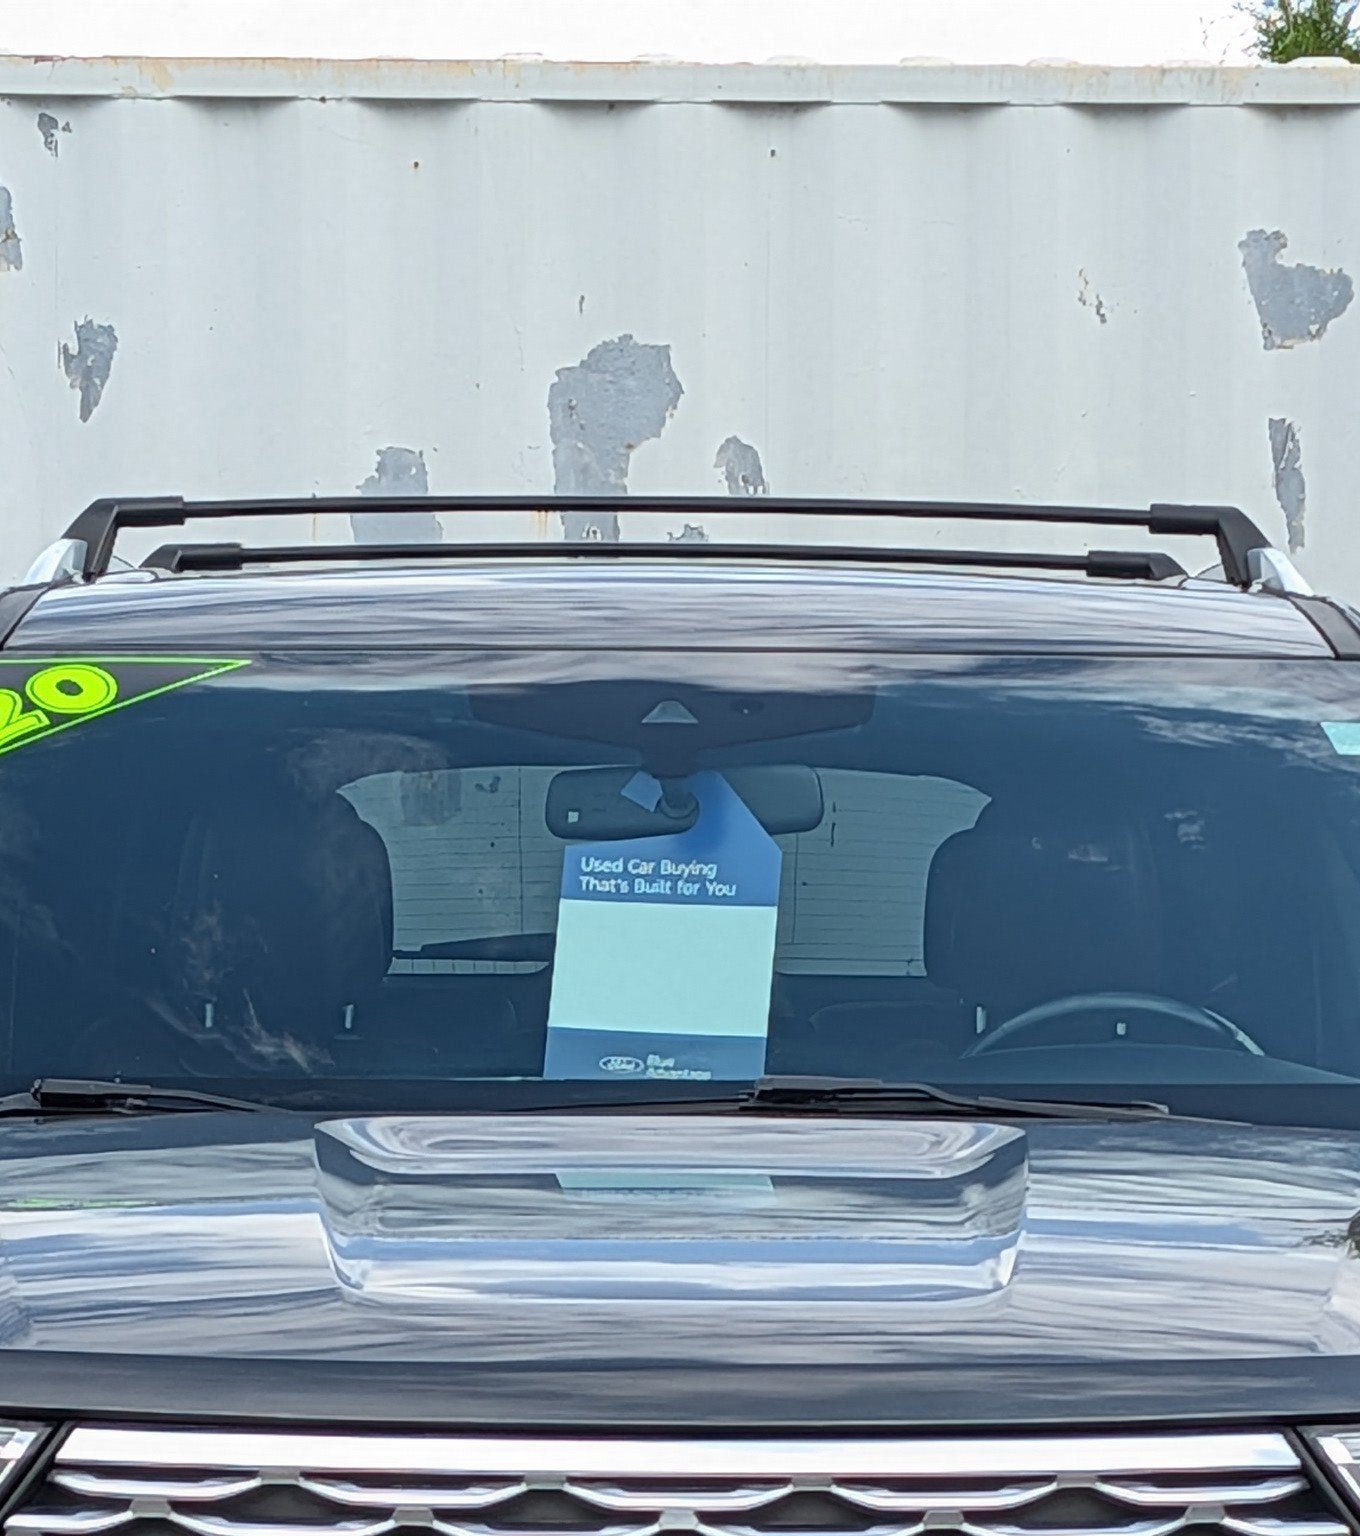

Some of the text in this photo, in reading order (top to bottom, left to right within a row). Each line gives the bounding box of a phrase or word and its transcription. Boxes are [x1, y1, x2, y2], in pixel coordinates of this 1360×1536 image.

[580, 857, 718, 879] Used Car Buying
[579, 876, 737, 896] That's Built for You
